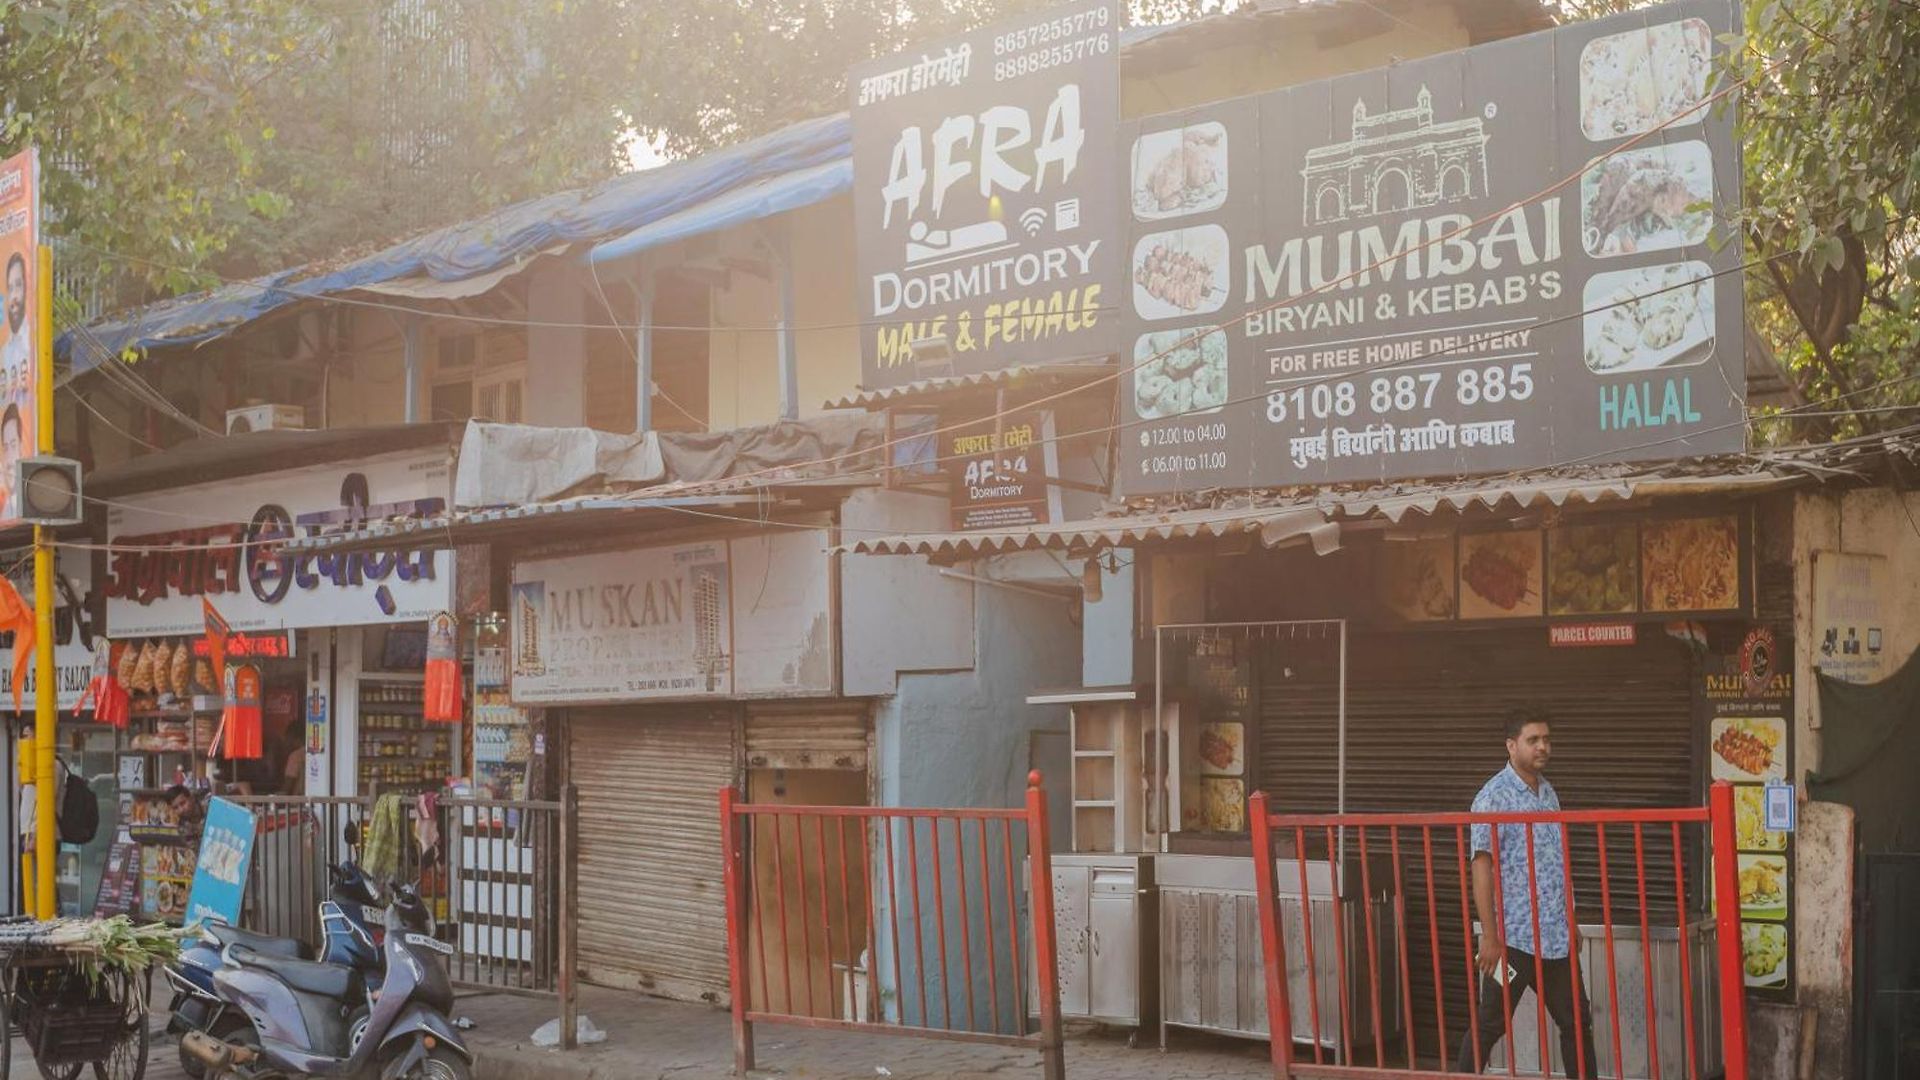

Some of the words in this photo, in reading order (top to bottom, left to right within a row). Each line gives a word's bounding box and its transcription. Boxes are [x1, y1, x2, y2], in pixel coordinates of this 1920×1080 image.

[994, 6, 1109, 56] 8657255779
[994, 33, 1109, 82] 8898255776
[858, 67, 910, 106] अफरा
[881, 84, 1085, 230] AFRA
[1245, 197, 1562, 303] MUMBAI
[955, 310, 976, 352] &
[984, 283, 1101, 350] FEMALE
[1245, 297, 1364, 337] BIRYANI
[1374, 293, 1397, 320] &
[1407, 270, 1562, 317] KEBAB'S
[1269, 354, 1307, 375] FOR
[1312, 348, 1360, 370] FREE
[1366, 340, 1423, 364] HOME
[1429, 330, 1531, 356] DELIVERY
[1266, 381, 1356, 423] 8108
[1370, 372, 1442, 414] 887
[1457, 363, 1534, 405] 885
[1599, 378, 1701, 430] HALAL
[1152, 427, 1180, 445] 12.00
[1183, 428, 1195, 443] to
[1198, 423, 1226, 441] 04.00
[1289, 426, 1328, 469] मुंबई
[1400, 418, 1456, 453] आणि
[1459, 419, 1515, 447] कबाब
[1152, 456, 1182, 473] 06.00
[1185, 456, 1196, 471] to
[1199, 451, 1226, 469] 11.00
[550, 577, 683, 632] MUSKAN
[1551, 627, 1586, 642] PARCEL
[1588, 625, 1633, 641] COUNTER
